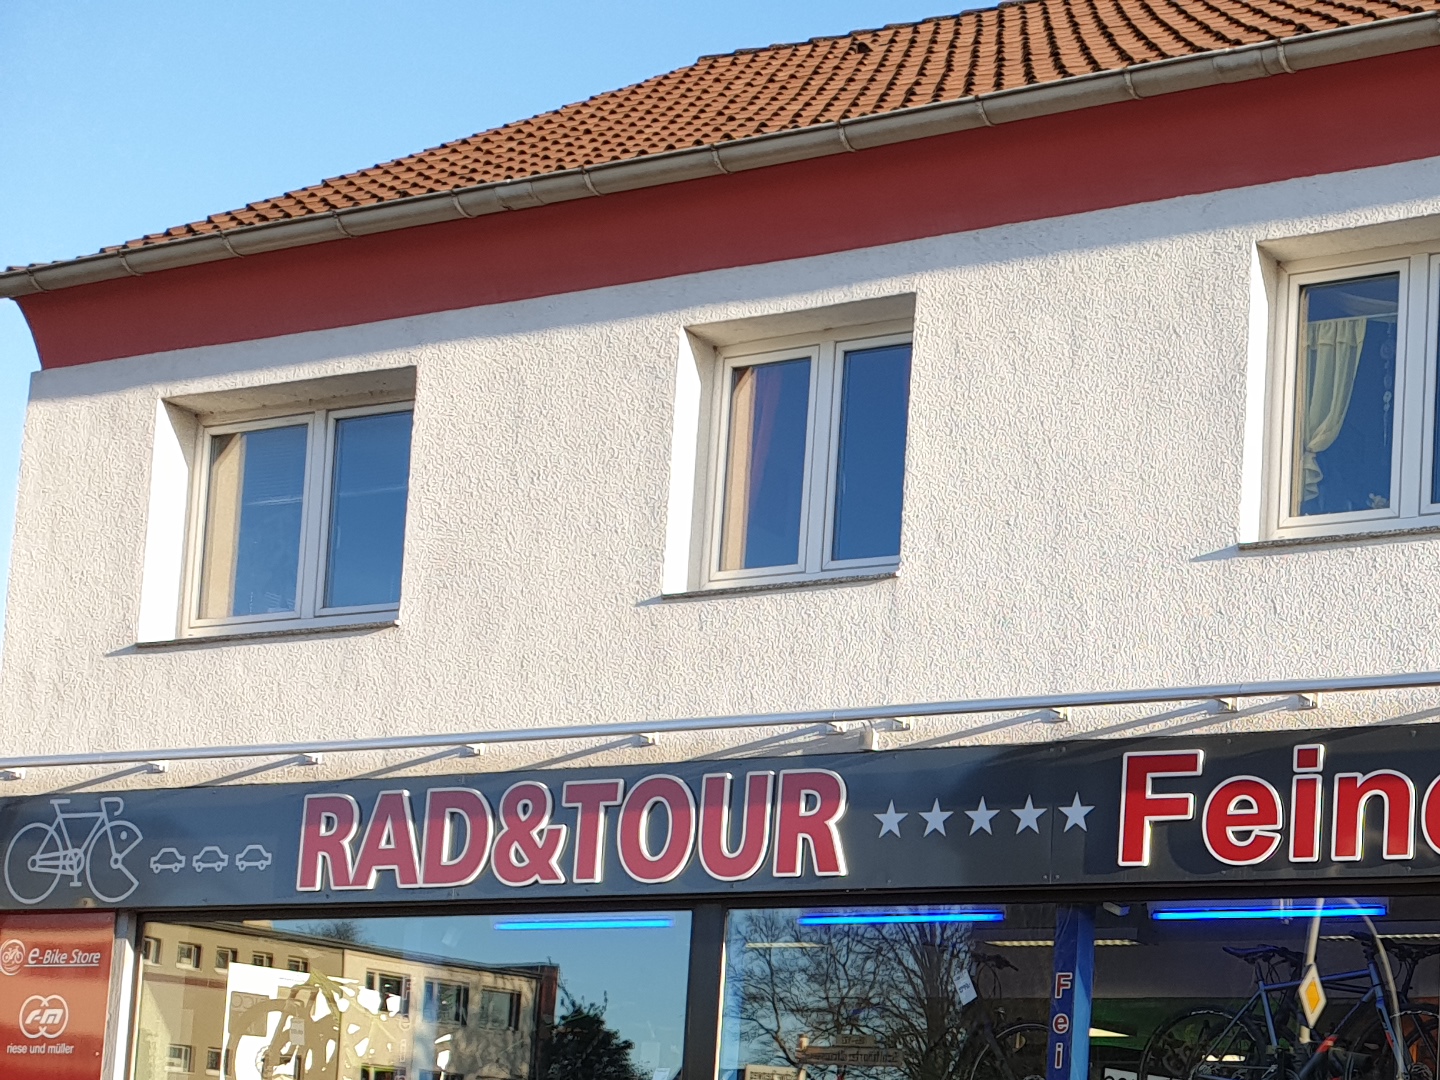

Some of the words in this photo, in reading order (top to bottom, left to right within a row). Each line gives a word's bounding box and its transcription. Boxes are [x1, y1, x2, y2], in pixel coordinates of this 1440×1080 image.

[296, 768, 849, 892] RAD&TOUR
[27, 946, 68, 965] e-Bike
[69, 948, 101, 965] Store
[6, 1043, 28, 1054] riese
[29, 1042, 47, 1054] und
[48, 1042, 75, 1055] müller
